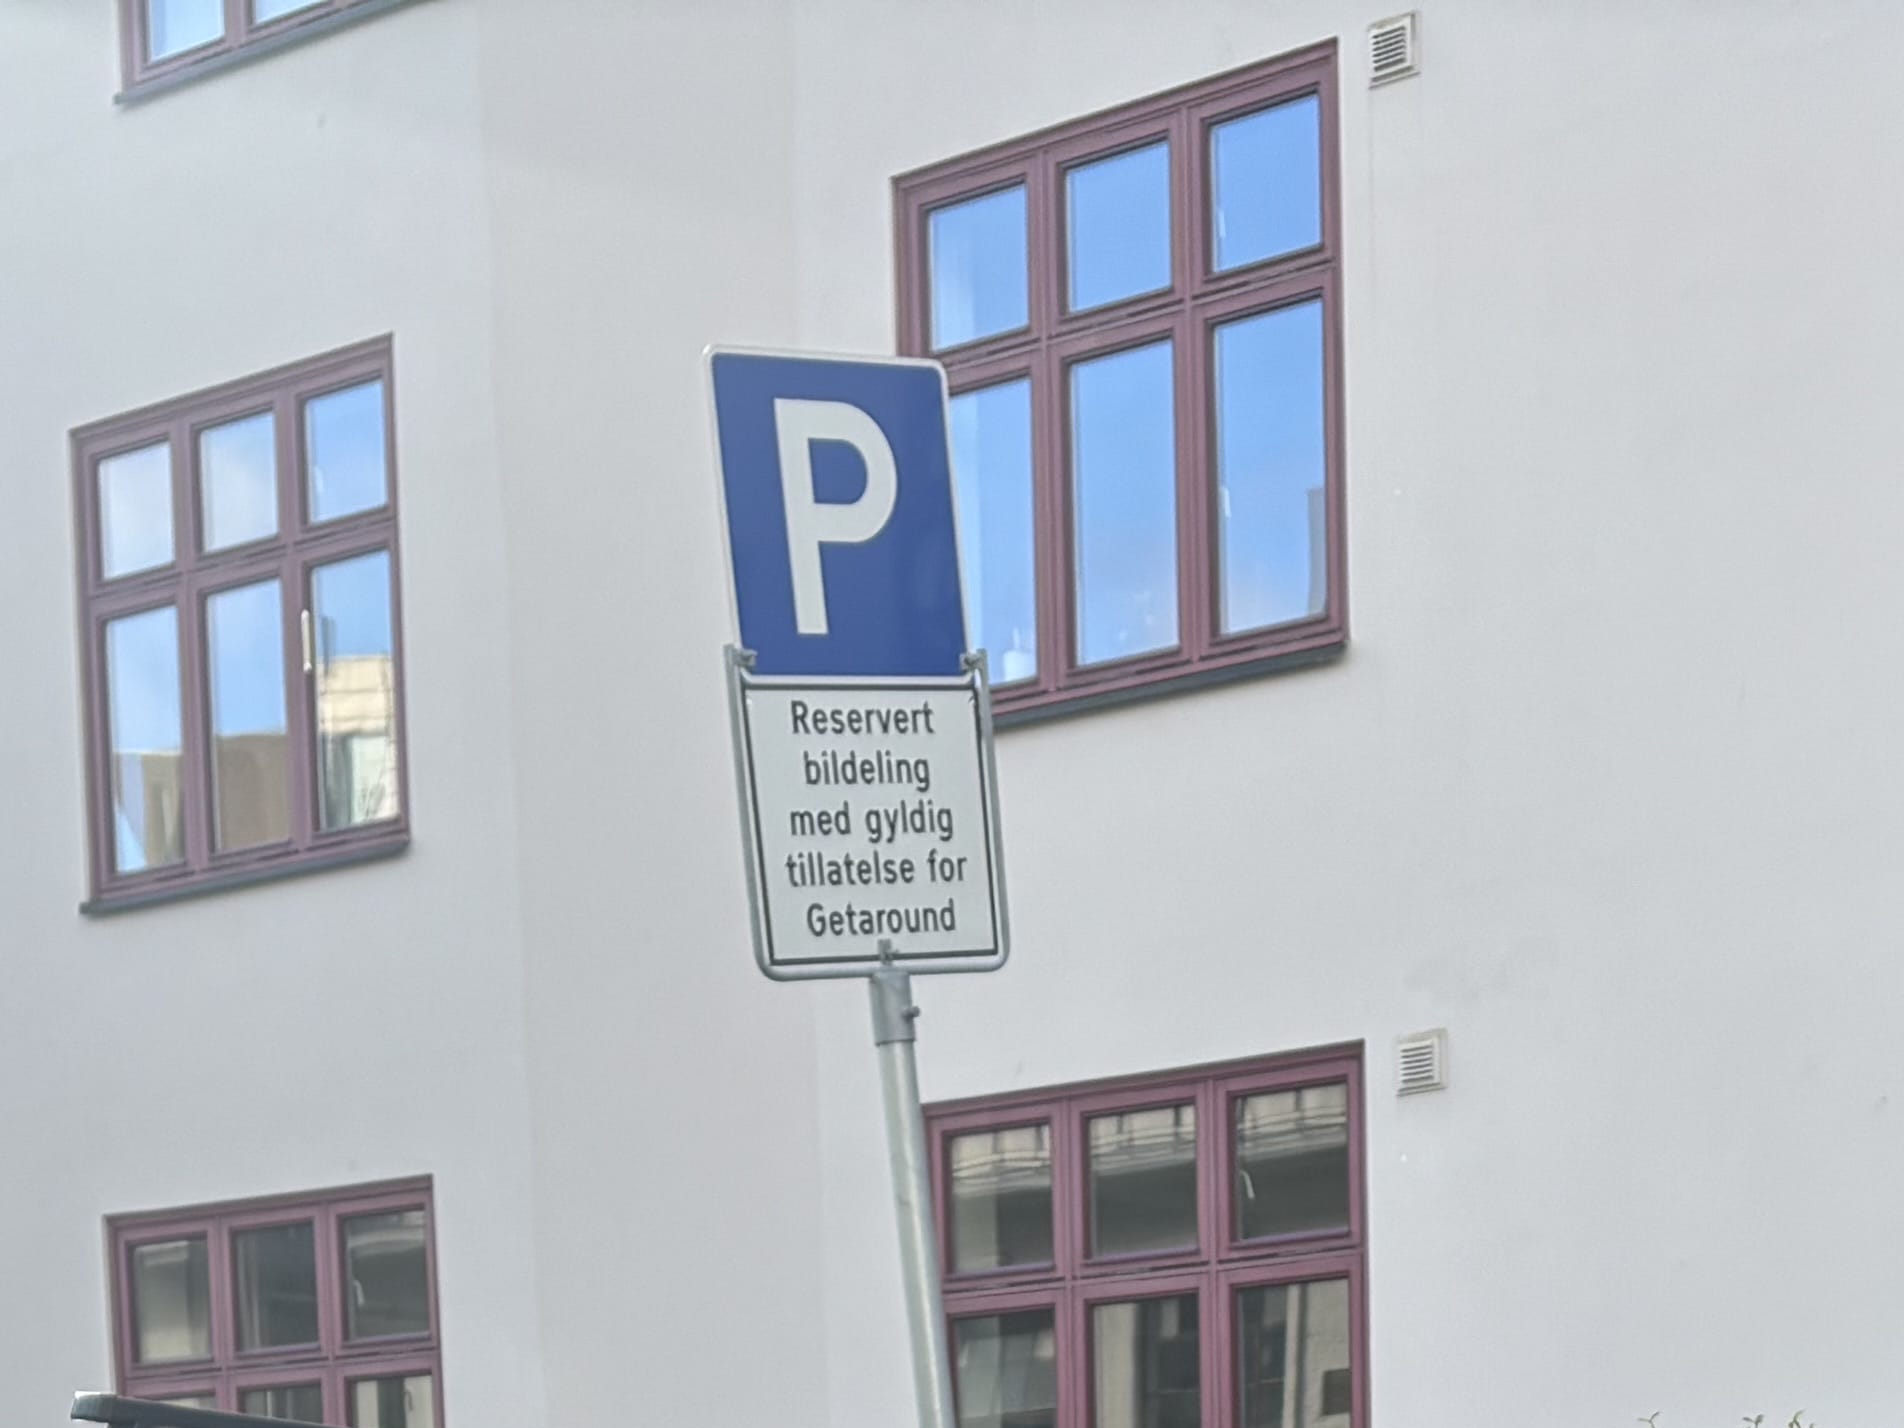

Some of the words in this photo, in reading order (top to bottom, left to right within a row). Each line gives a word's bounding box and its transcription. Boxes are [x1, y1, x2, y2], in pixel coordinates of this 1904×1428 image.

[774, 397, 897, 635] P
[791, 699, 935, 735] Reservert
[805, 752, 930, 793] bildeling
[790, 801, 851, 837] med
[866, 800, 954, 844] gyldig
[785, 850, 915, 888] tillatelse
[927, 850, 968, 883] for
[806, 898, 956, 938] Getaround
